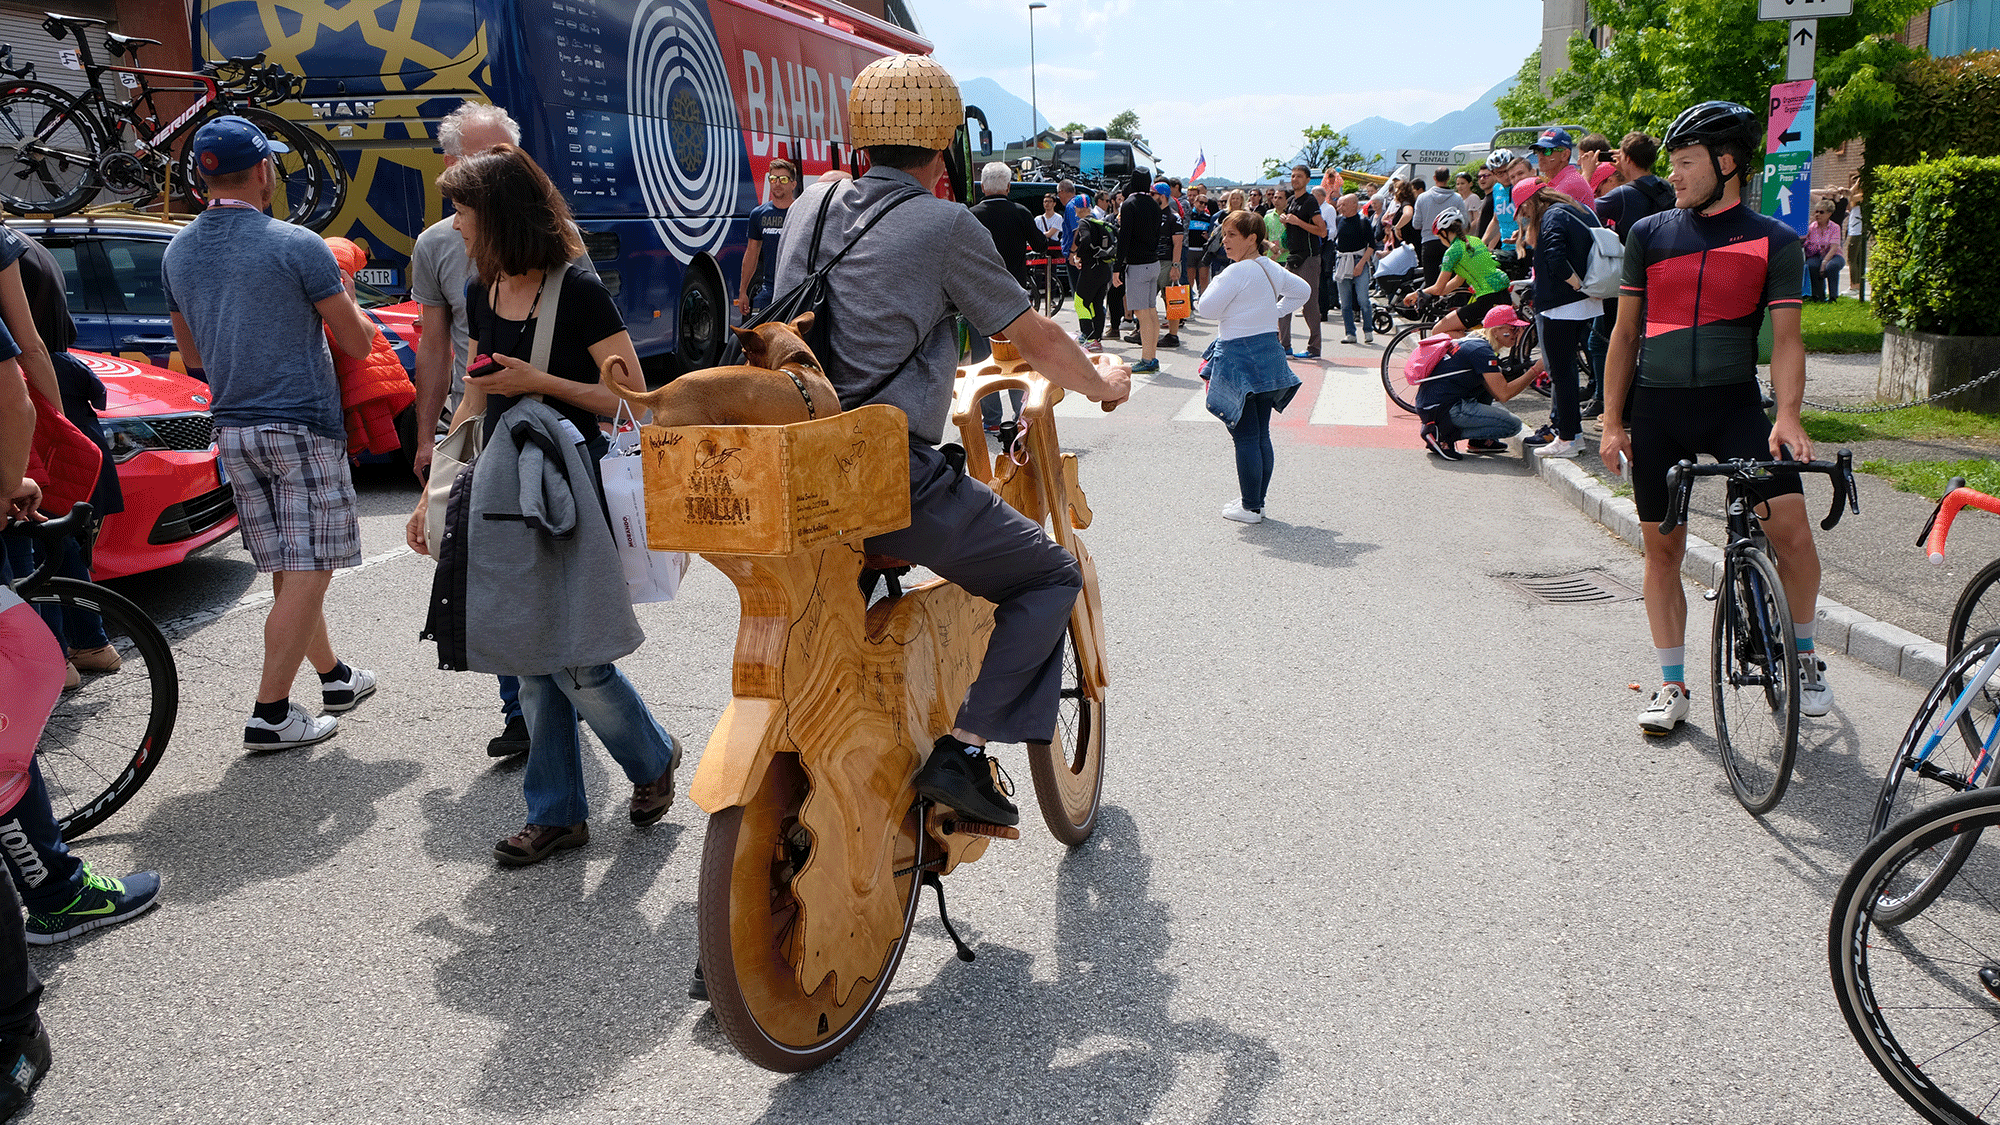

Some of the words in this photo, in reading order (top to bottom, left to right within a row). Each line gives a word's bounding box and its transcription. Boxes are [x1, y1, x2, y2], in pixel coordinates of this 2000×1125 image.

[61, 51, 78, 66] 44
[312, 101, 375, 118] MAN
[743, 49, 866, 166] BAHRA
[1769, 97, 1781, 118] P
[149, 95, 208, 148] MERIDA
[1764, 164, 1777, 184] P
[761, 215, 784, 227] BAHR
[690, 474, 732, 495] VIVA
[684, 496, 750, 521] ITALIA!
[622, 516, 634, 547] MORANDO
